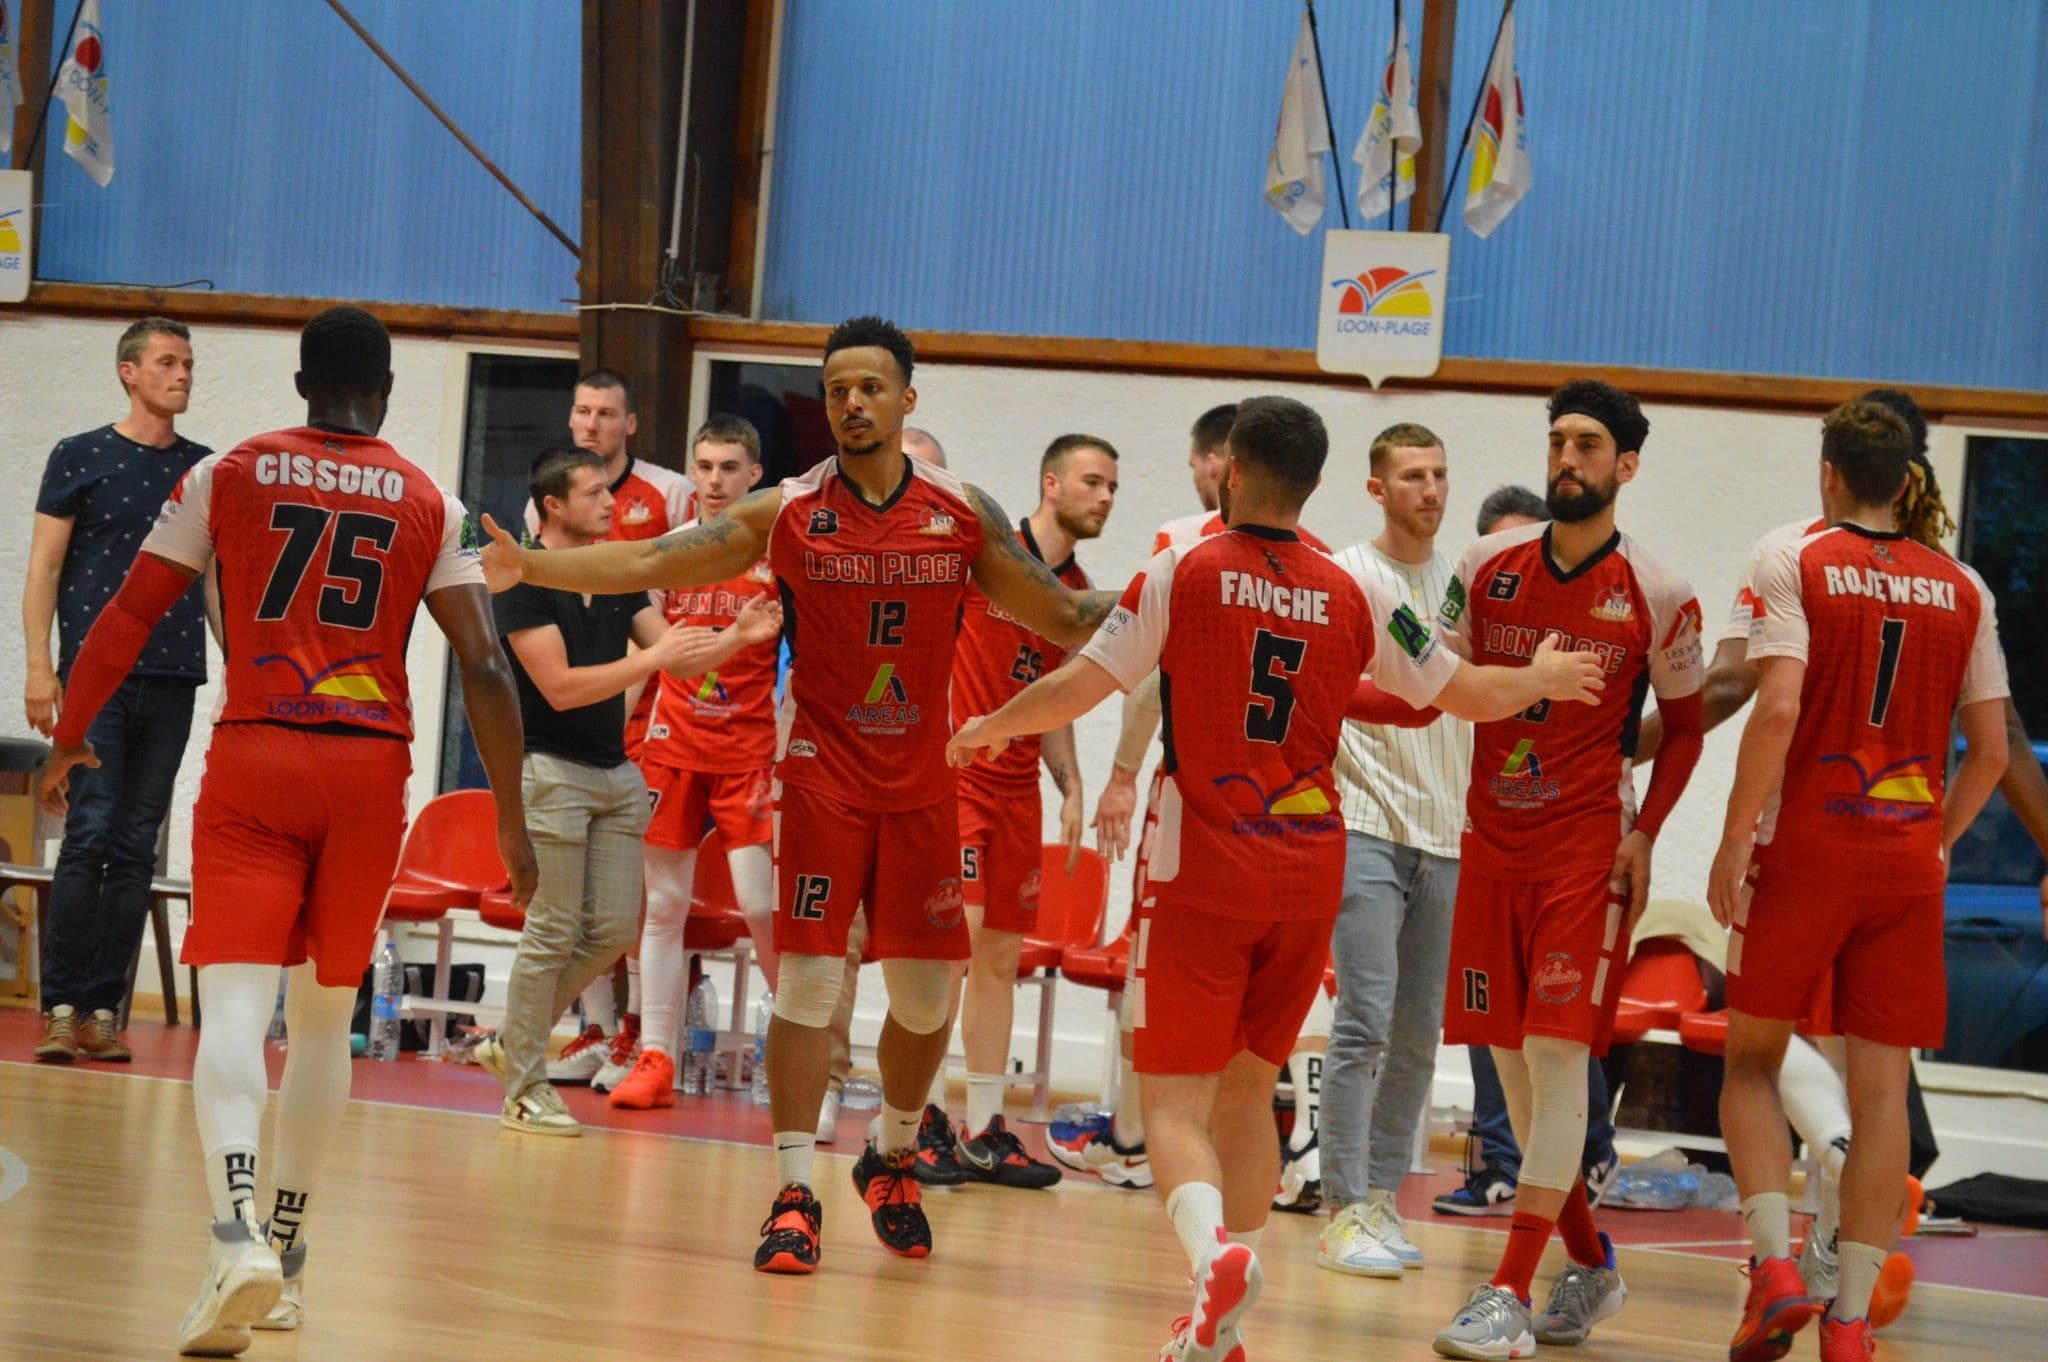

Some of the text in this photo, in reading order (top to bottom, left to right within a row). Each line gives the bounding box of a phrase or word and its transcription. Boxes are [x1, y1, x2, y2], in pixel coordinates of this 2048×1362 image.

[1337, 319, 1431, 336] LOON-PLAGE
[255, 452, 404, 502] CISSOKO
[255, 503, 398, 630] 75
[805, 551, 961, 585] LOON PLAGE
[1824, 566, 1956, 612] ROJEWSKI
[1220, 570, 1330, 625] FAUCHE
[867, 600, 907, 646] 12
[1009, 642, 1044, 685] 25
[1869, 616, 1907, 728] 1
[1244, 628, 1307, 746] 5
[268, 700, 389, 722] LOON-PLAGE
[846, 704, 920, 725] AREAS
[1489, 776, 1561, 800] AREAS
[792, 874, 831, 921] 12
[1463, 967, 1489, 1014] 16
